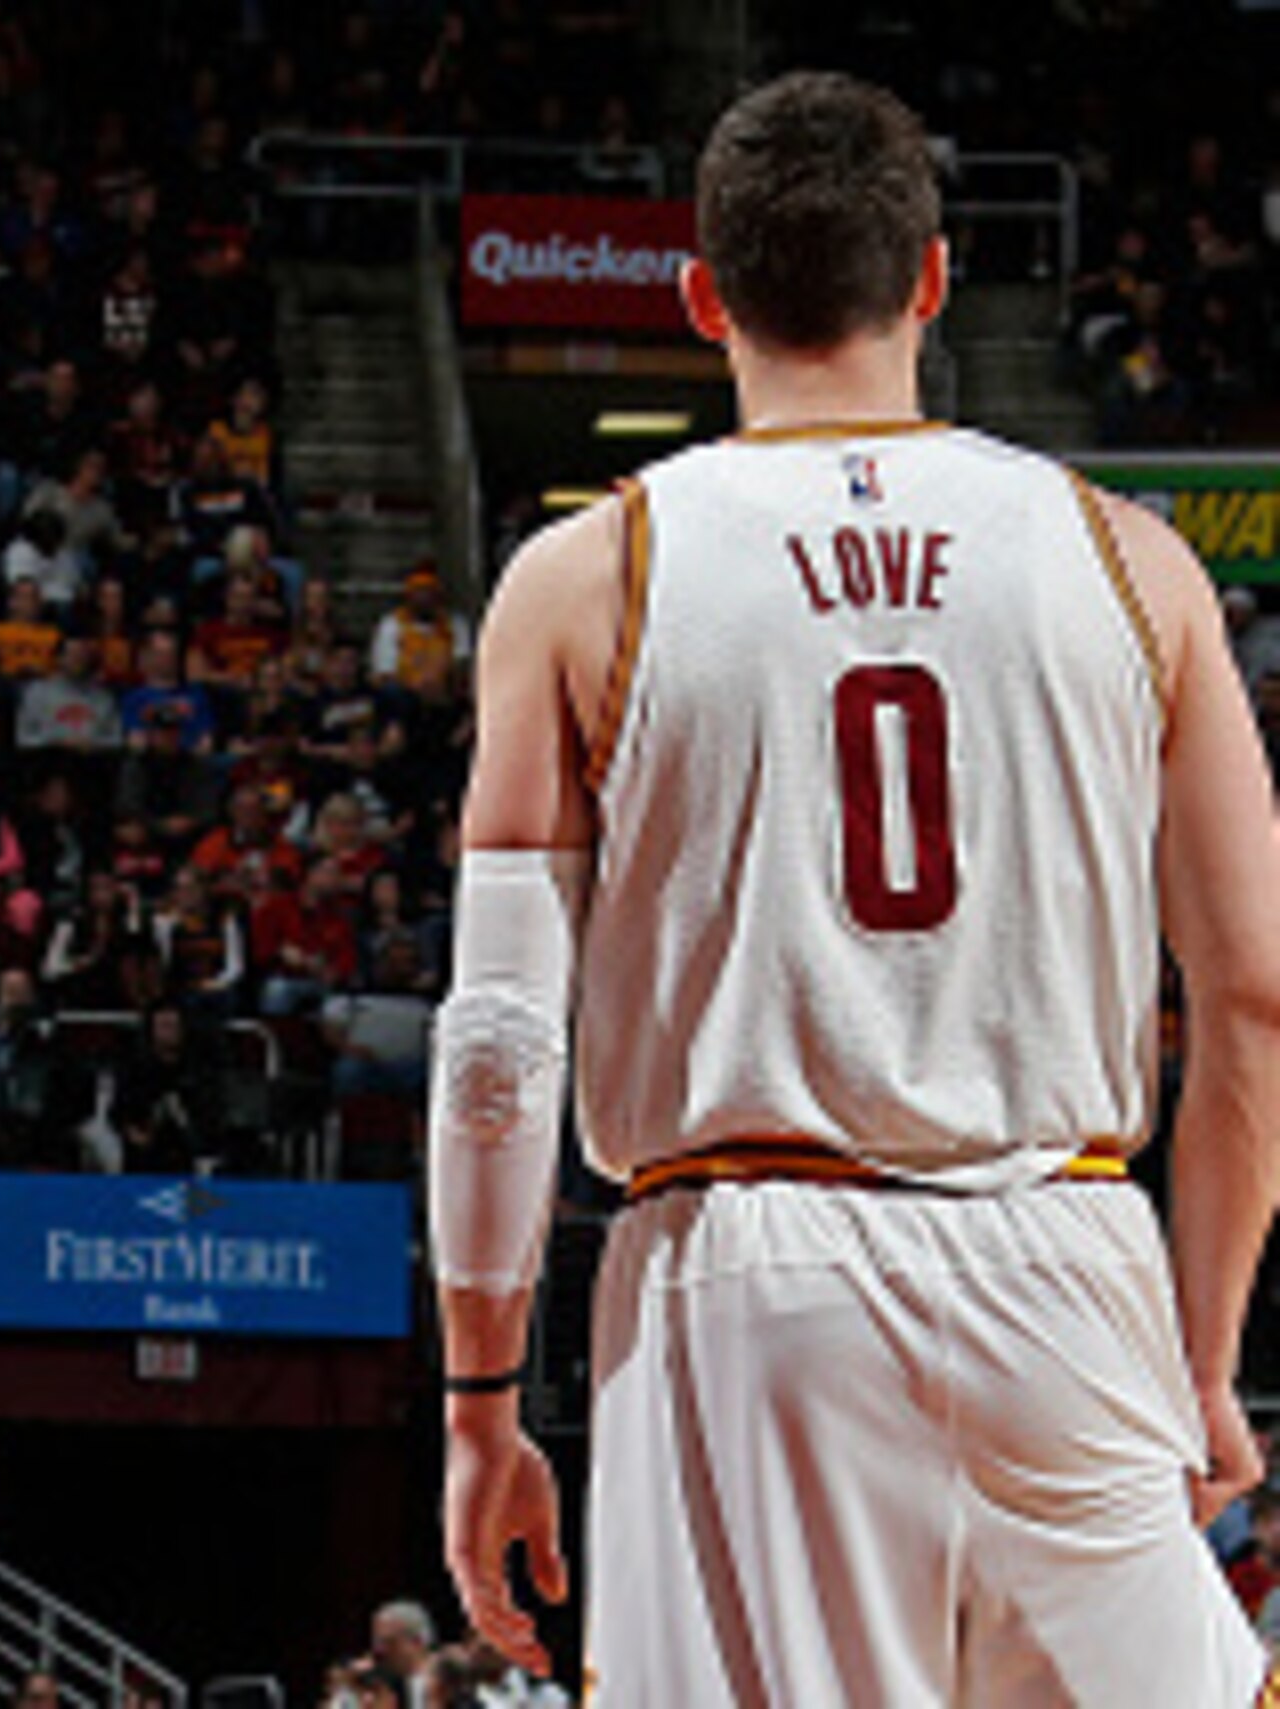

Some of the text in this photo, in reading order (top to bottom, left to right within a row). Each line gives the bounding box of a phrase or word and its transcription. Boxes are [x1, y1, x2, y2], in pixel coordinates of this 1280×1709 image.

[470, 231, 690, 284] Quicken
[1136, 491, 1280, 559] WA
[786, 525, 955, 615] LOVE
[832, 664, 957, 930] 0
[144, 1295, 220, 1324] Bank
